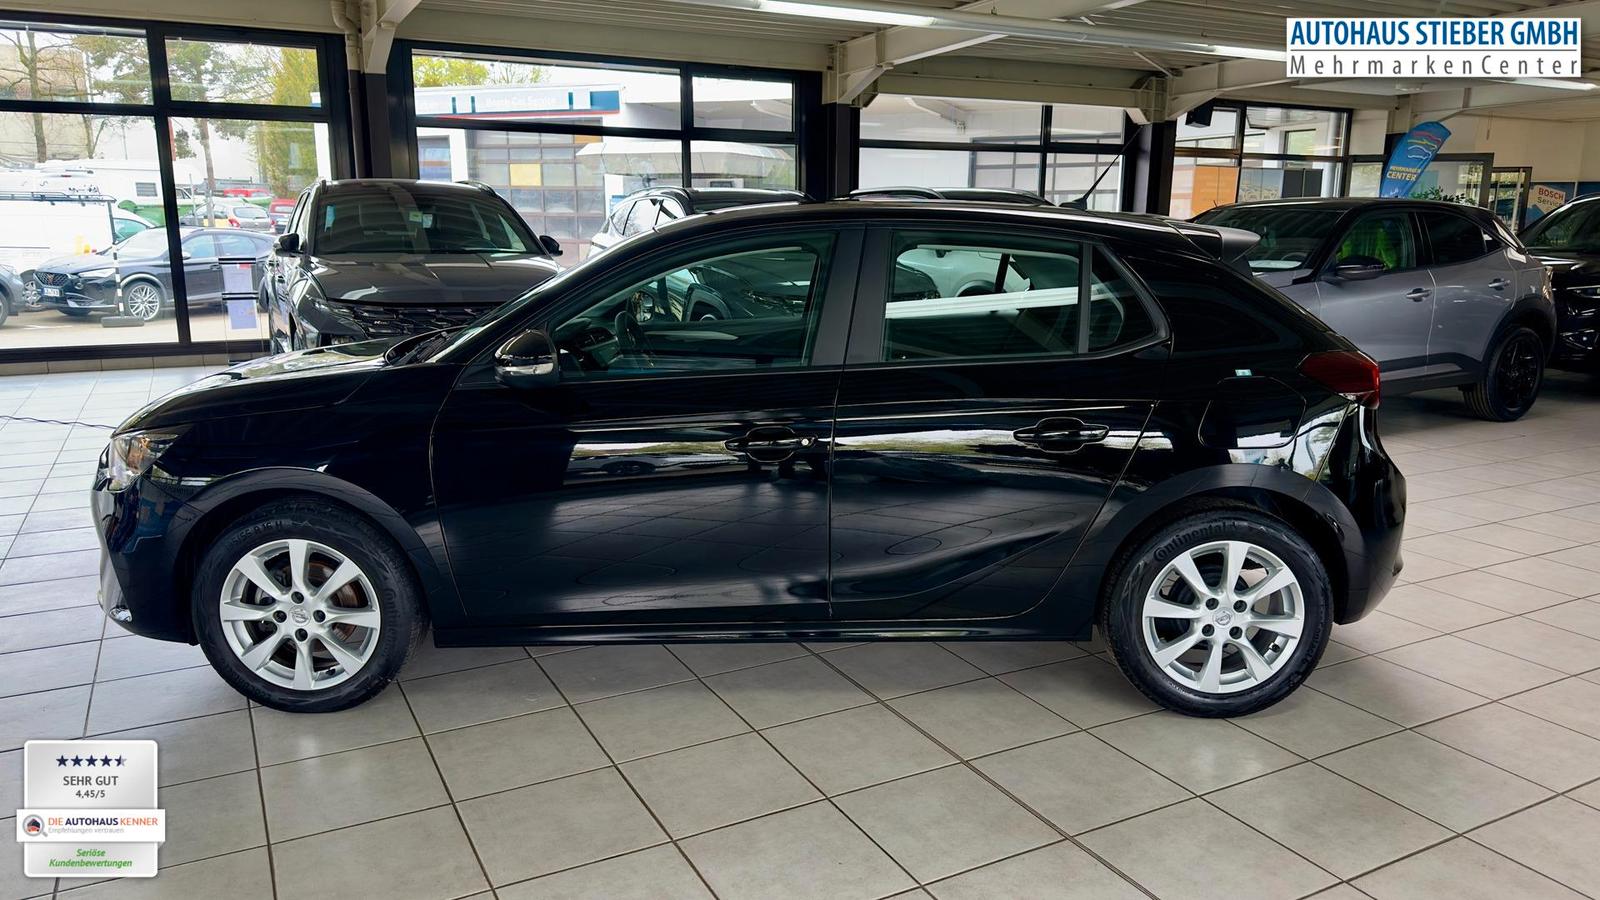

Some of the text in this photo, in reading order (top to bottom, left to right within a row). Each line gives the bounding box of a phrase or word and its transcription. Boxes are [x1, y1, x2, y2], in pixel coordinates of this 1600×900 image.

[1386, 171, 1417, 182] CENTER
[1538, 187, 1564, 201] BOSCH
[1153, 521, 1227, 561] Continental
